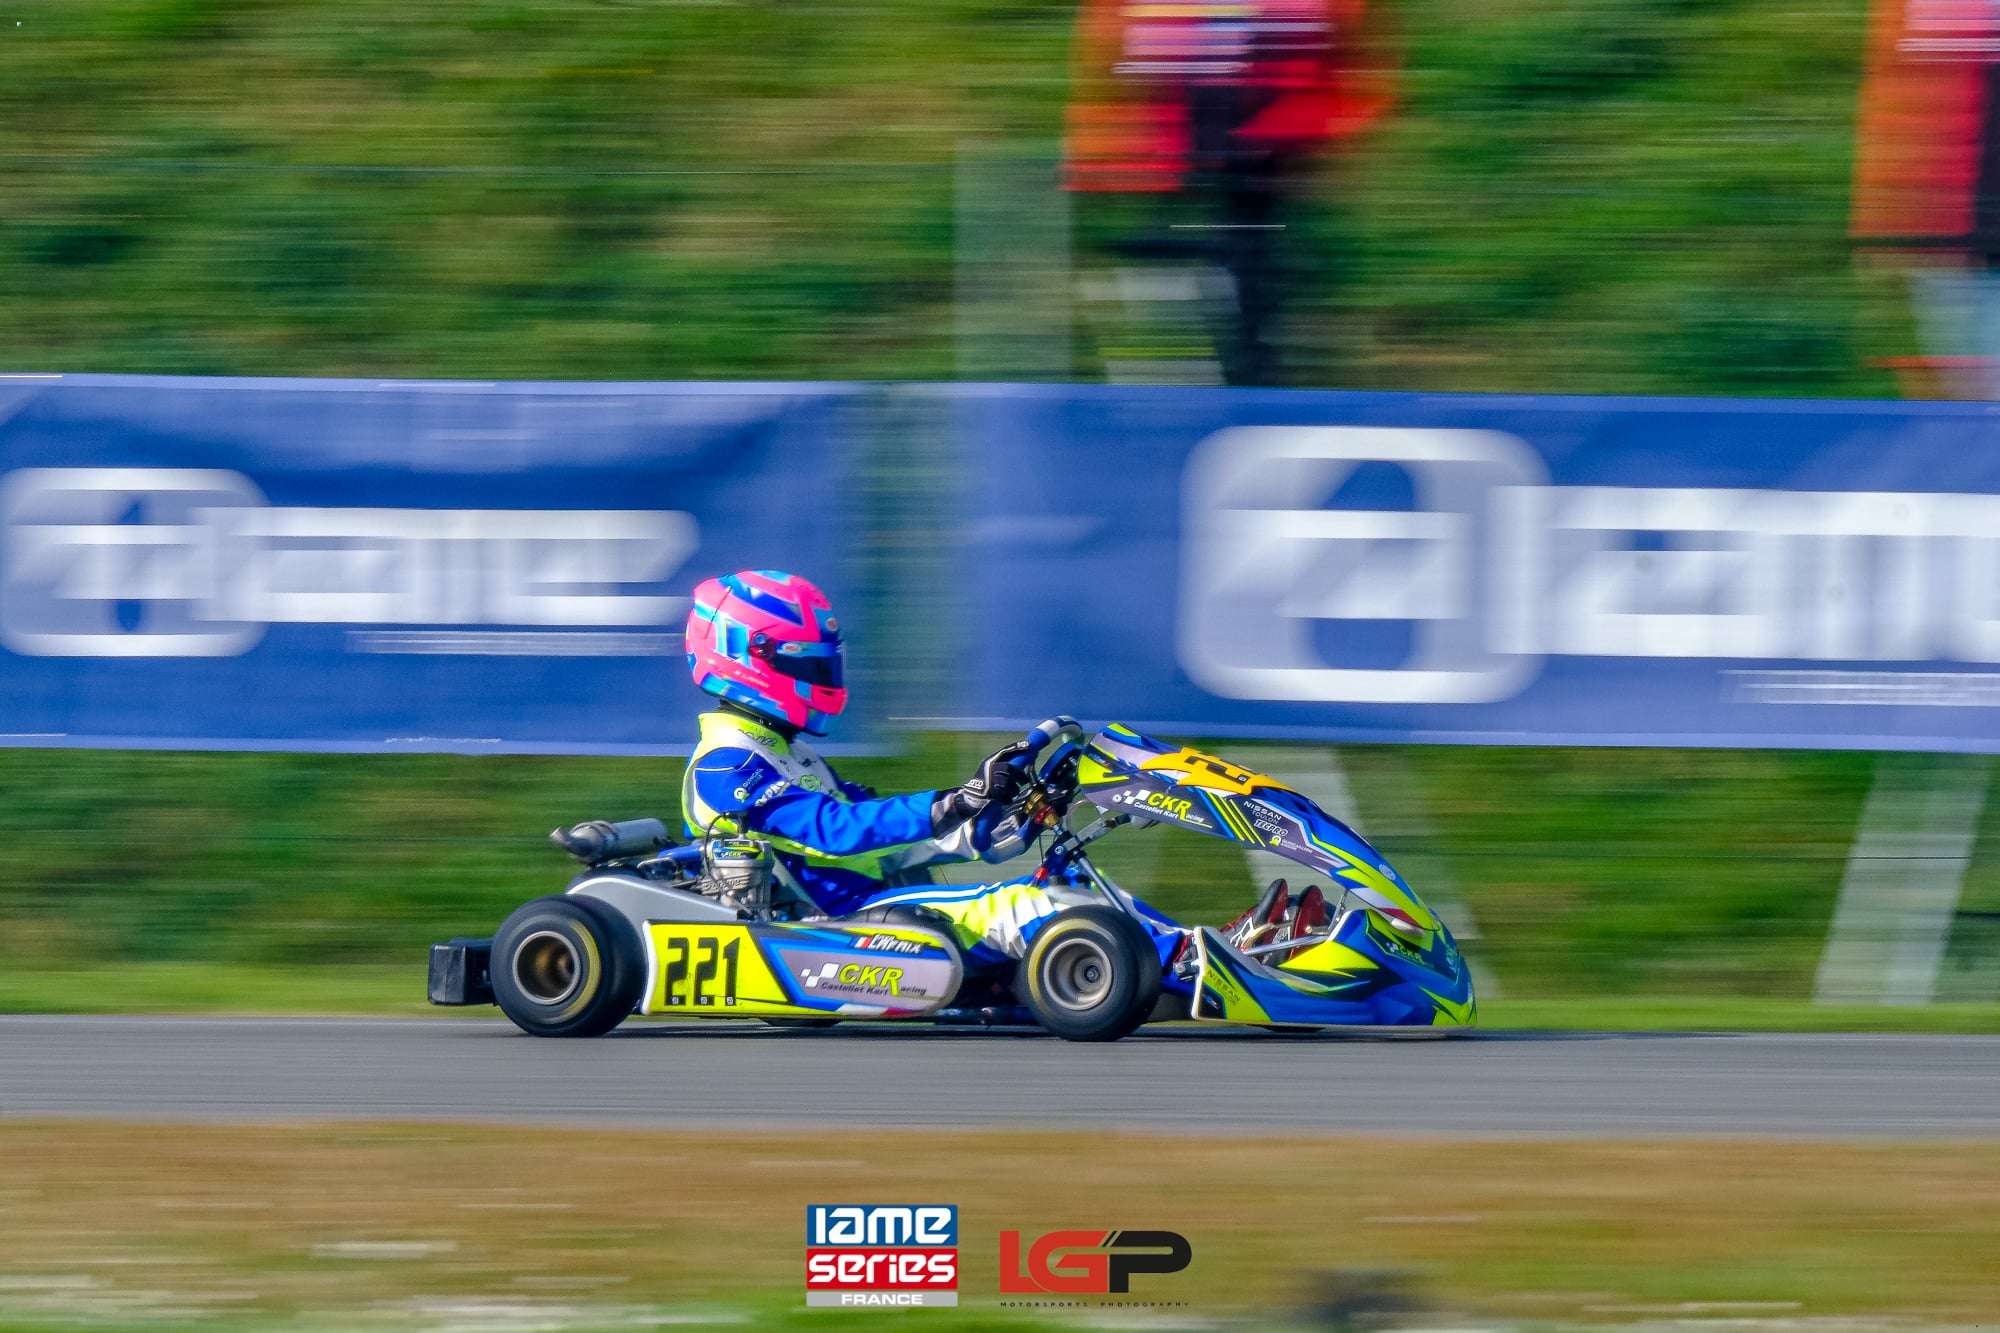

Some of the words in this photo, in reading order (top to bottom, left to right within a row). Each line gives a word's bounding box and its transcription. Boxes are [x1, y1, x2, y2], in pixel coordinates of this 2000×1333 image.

[1148, 793, 1192, 820] CKR
[1243, 801, 1282, 820] NISSAN
[1252, 810, 1280, 825] TOULON
[1253, 819, 1289, 836] TECPRO
[664, 936, 741, 1006] 221
[839, 962, 904, 996] CKR
[821, 982, 864, 993] Castellet
[866, 987, 889, 996] Kart
